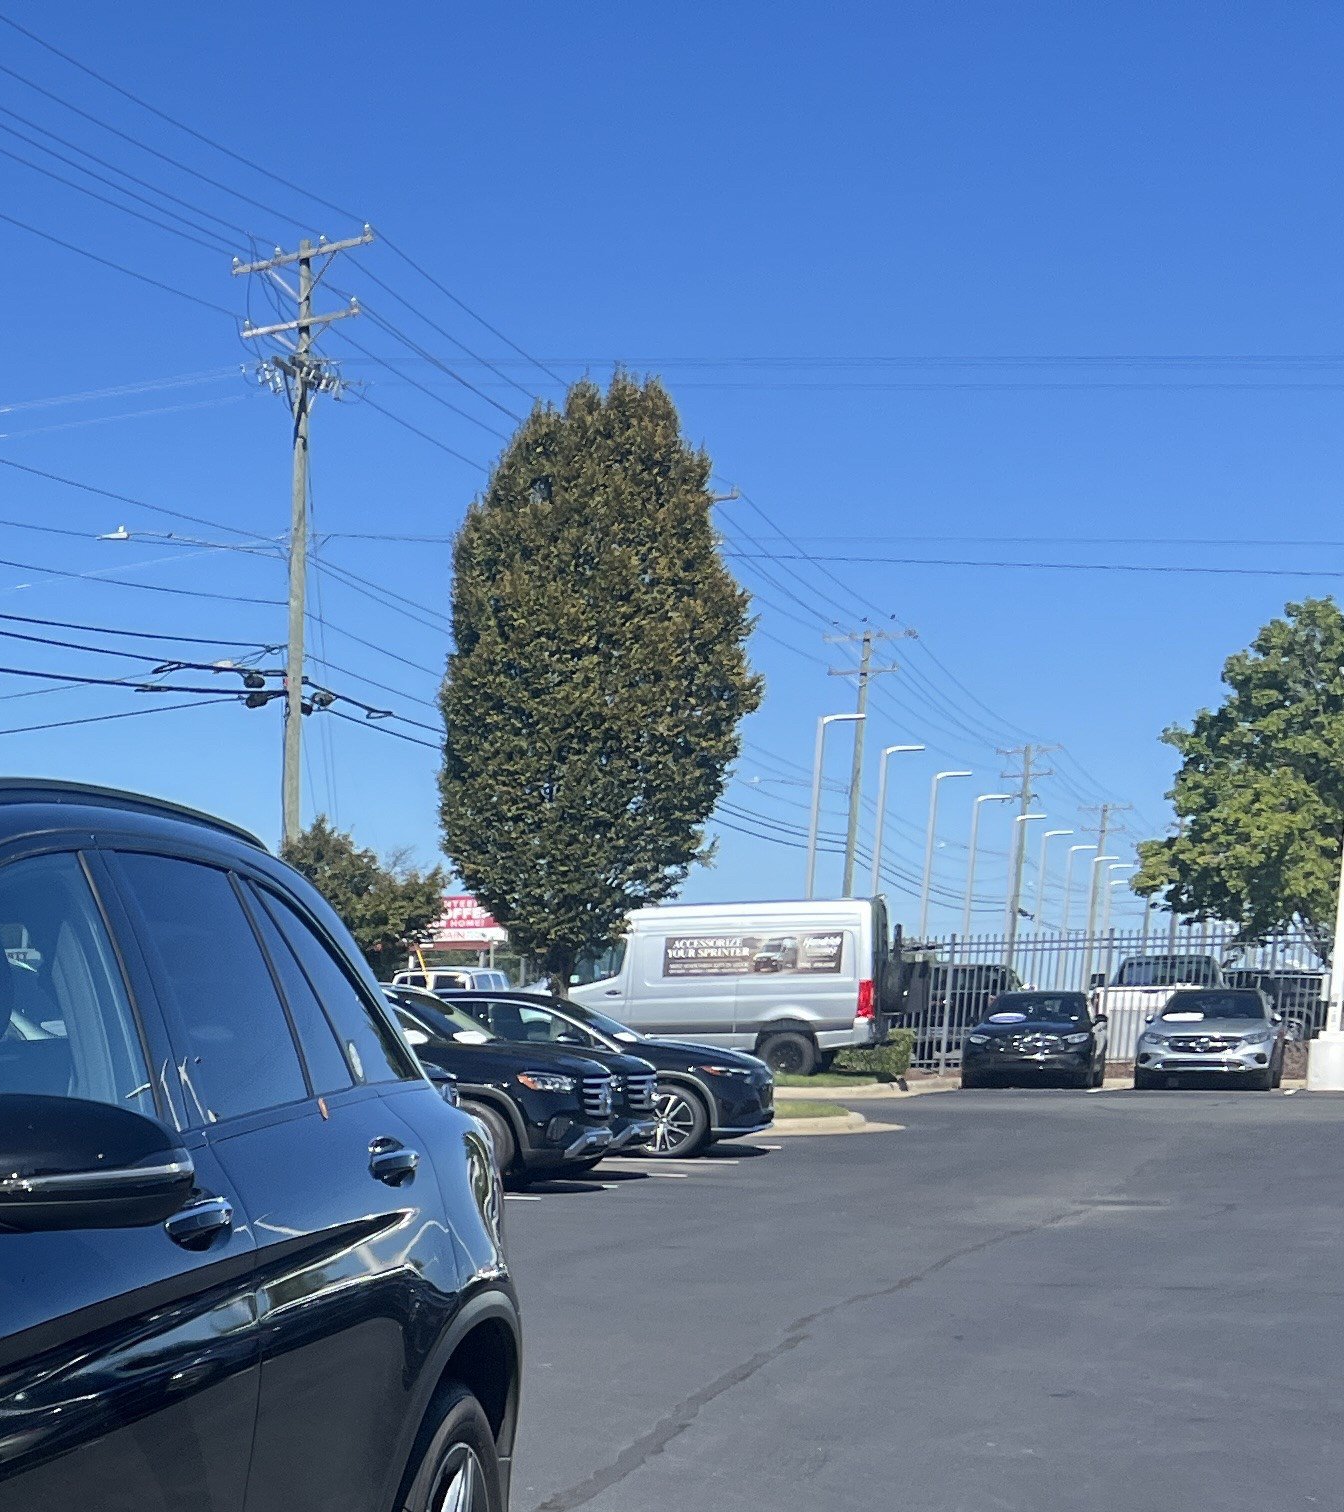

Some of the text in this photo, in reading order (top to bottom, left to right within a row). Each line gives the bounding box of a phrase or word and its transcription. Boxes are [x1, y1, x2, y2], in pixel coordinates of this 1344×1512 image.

[673, 937, 743, 948] ACCESSORIZE
[667, 947, 750, 958] YOUR SPRINTER
